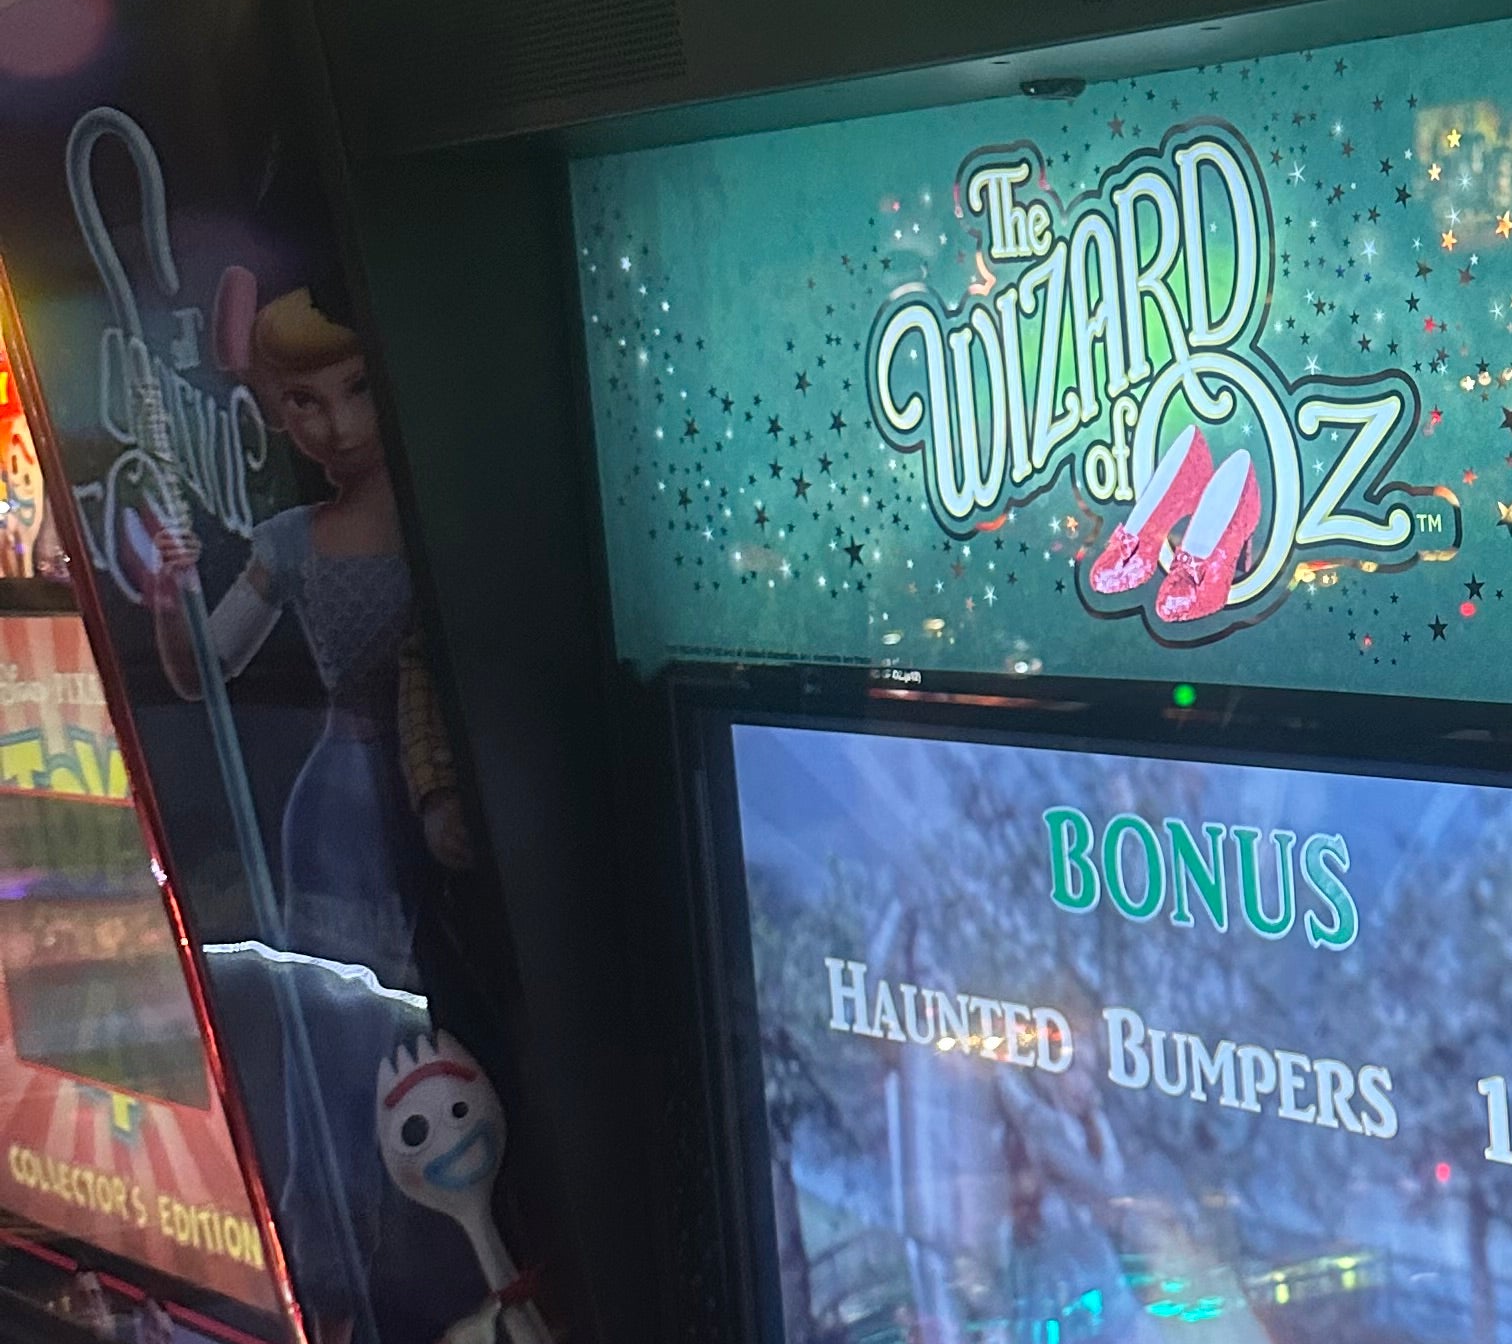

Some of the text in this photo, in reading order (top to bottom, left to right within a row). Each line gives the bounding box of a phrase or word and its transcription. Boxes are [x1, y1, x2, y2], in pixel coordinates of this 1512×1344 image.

[968, 163, 1053, 260] The
[1084, 395, 1138, 501] of
[1042, 805, 1360, 952] BONUS
[1102, 1007, 1400, 1140] BUMPERS
[156, 1194, 267, 1272] EDITION
